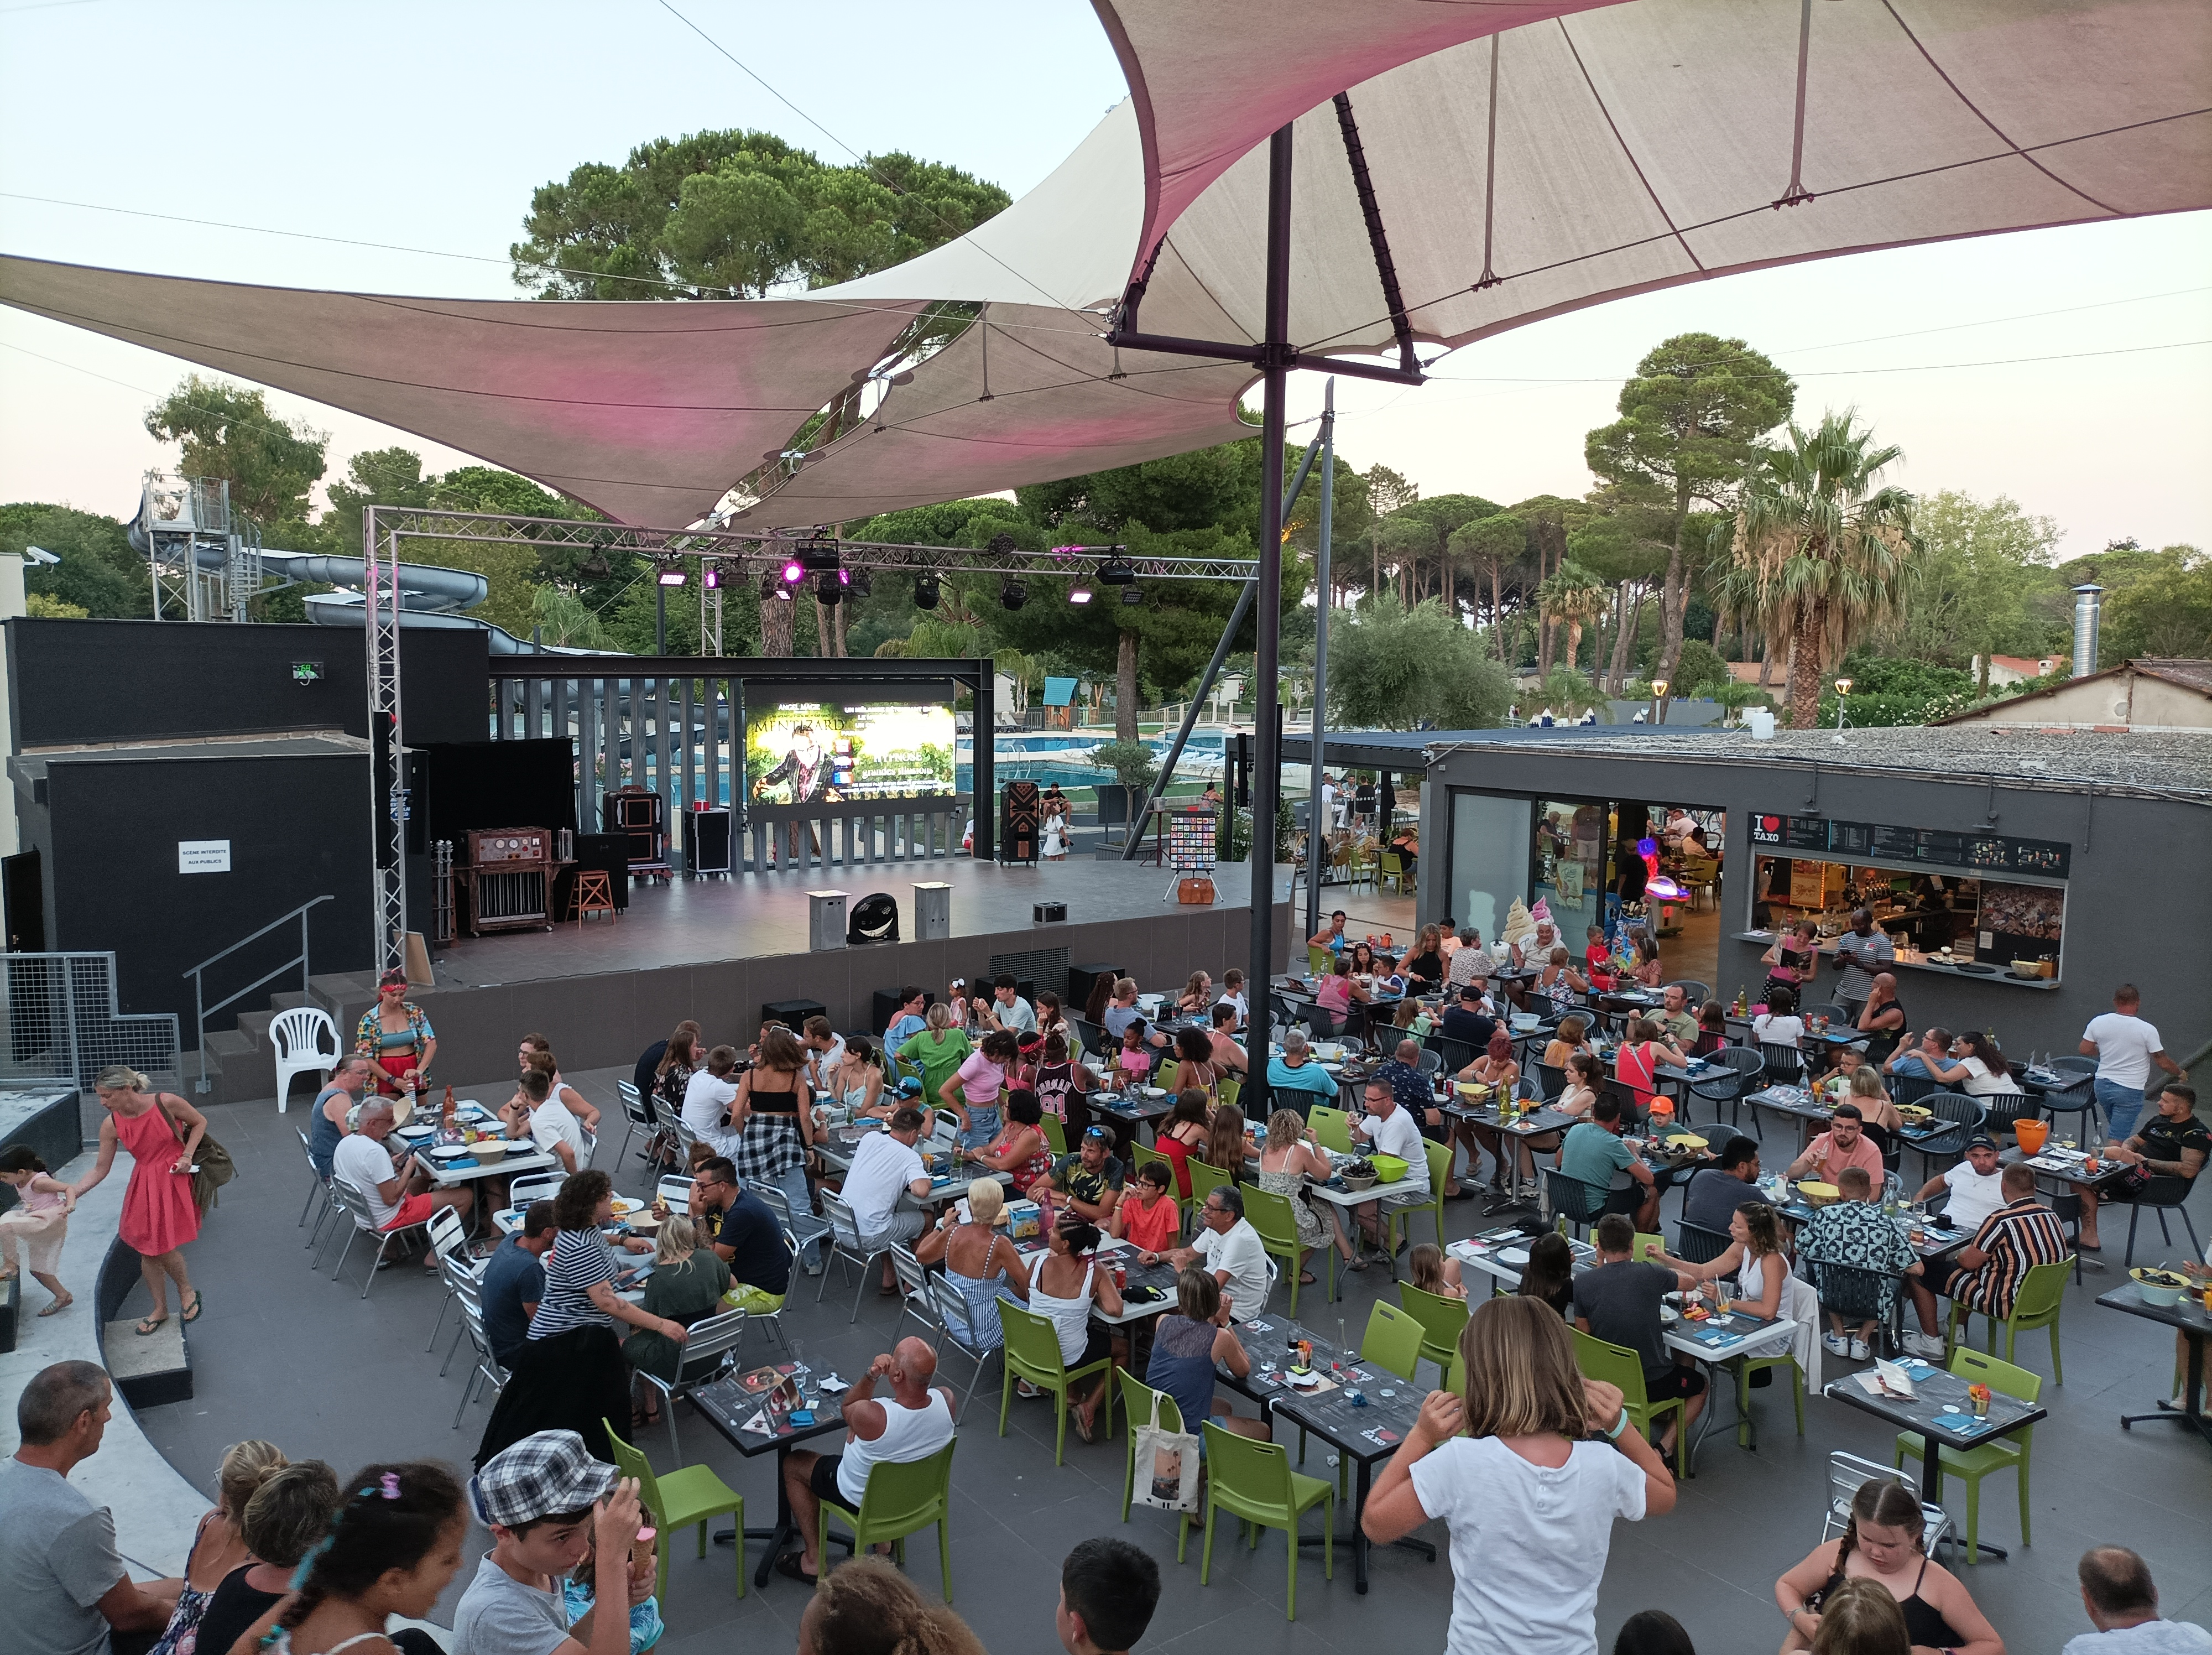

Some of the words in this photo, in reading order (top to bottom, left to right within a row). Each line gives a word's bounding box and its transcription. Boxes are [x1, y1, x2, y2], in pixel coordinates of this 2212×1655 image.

[755, 719, 844, 732] MENTIZARD
[874, 752, 922, 762] HYPNOSE
[862, 767, 896, 779] grandes
[898, 766, 933, 775] illusions
[1754, 815, 1764, 831] I
[1754, 831, 1779, 842] TAXO
[1036, 1078, 1072, 1097] RODMAN
[1040, 1093, 1068, 1124] 91
[1360, 1430, 1386, 1446] TAXO
